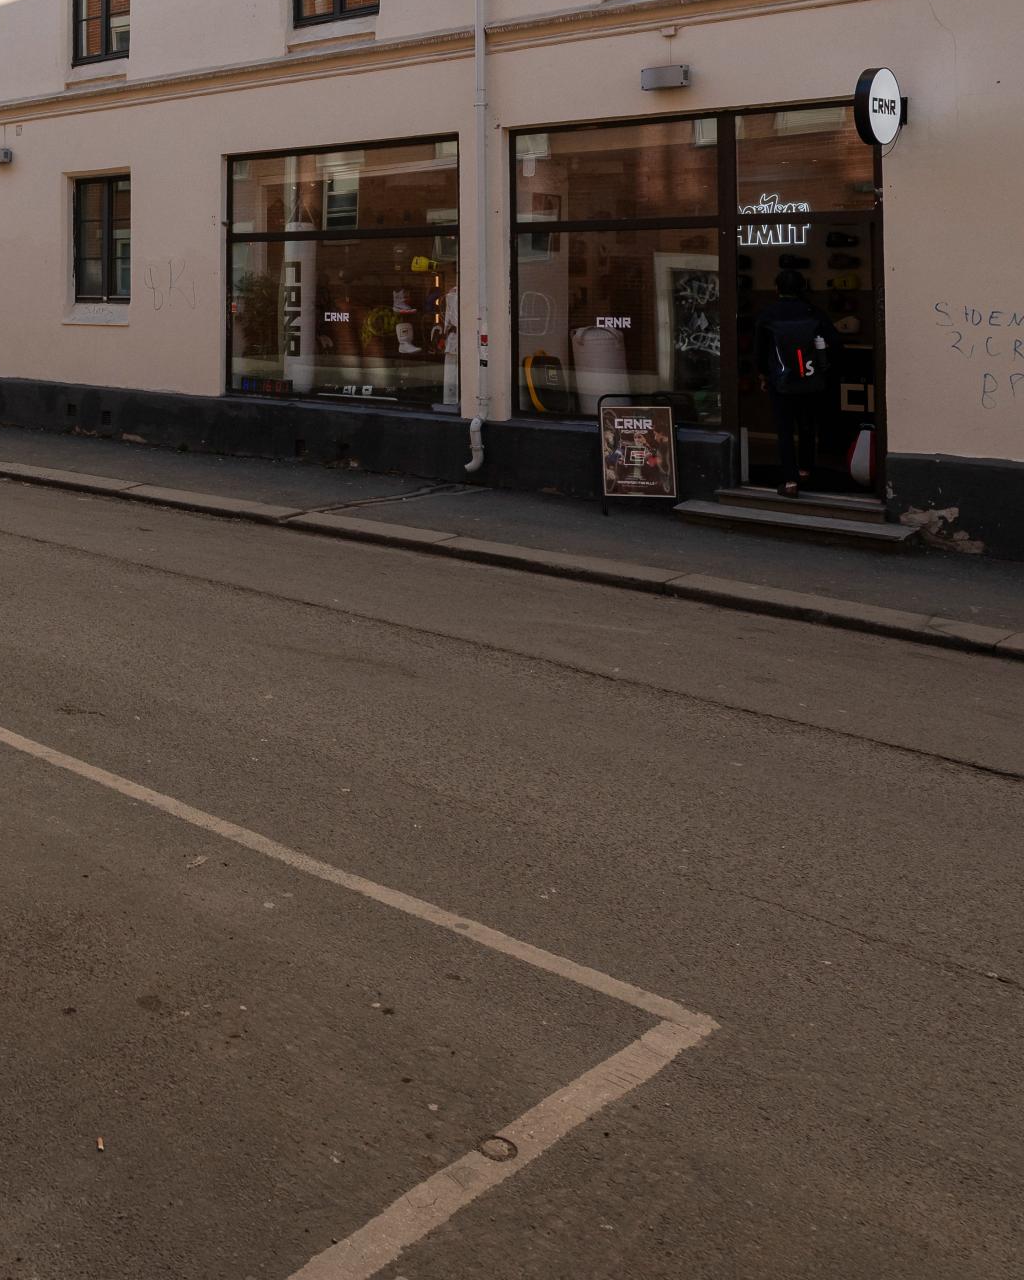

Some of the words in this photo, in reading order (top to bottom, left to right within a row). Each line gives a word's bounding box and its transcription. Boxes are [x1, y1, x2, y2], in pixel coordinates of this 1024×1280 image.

[872, 97, 896, 115] CRNR
[324, 312, 349, 322] CRNR
[596, 317, 631, 328] CRNR
[614, 418, 653, 430] CRNR
